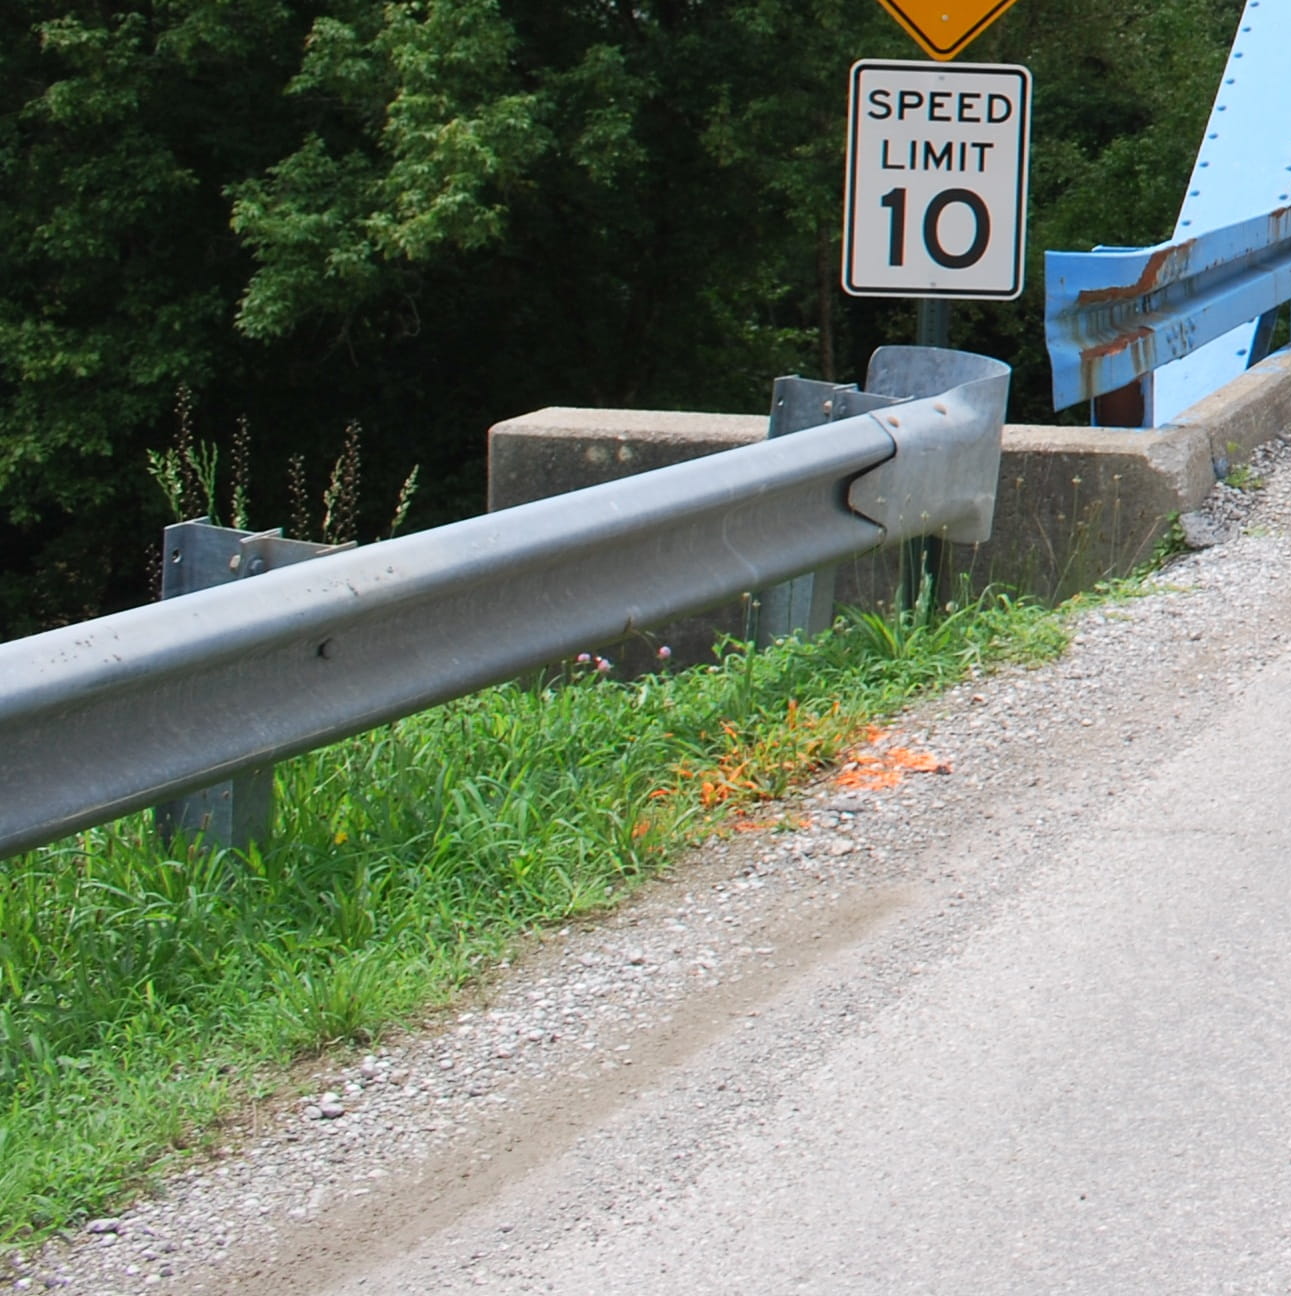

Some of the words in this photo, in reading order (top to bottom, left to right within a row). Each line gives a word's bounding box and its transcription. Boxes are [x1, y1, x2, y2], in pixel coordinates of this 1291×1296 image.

[867, 89, 1013, 124] SPEED
[881, 139, 994, 173] LIMIT
[880, 187, 992, 270] 10
